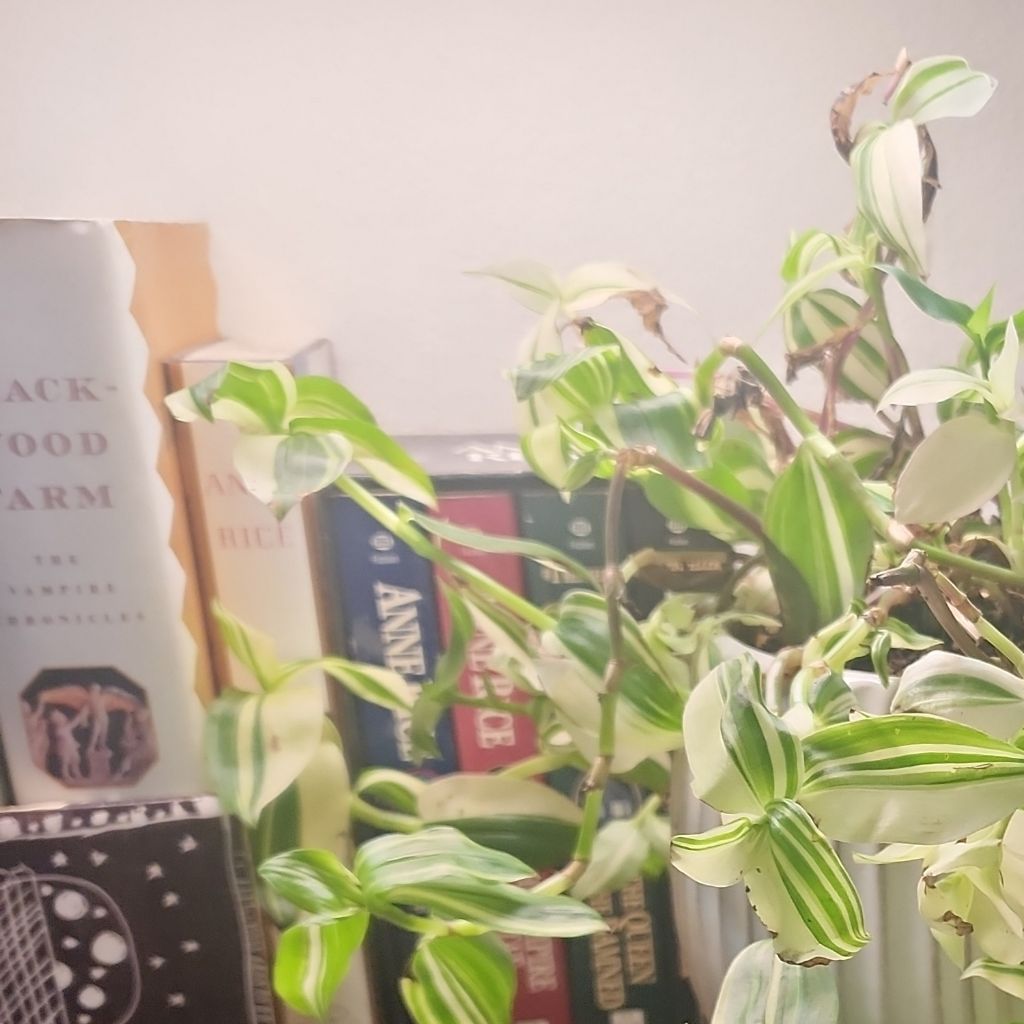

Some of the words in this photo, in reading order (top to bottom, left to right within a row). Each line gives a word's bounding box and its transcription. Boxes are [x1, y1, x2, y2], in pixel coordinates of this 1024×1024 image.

[0, 432, 108, 458] OOD
[0, 485, 115, 511] ARM
[217, 526, 294, 550] RICE
[374, 581, 426, 675] ANNE
